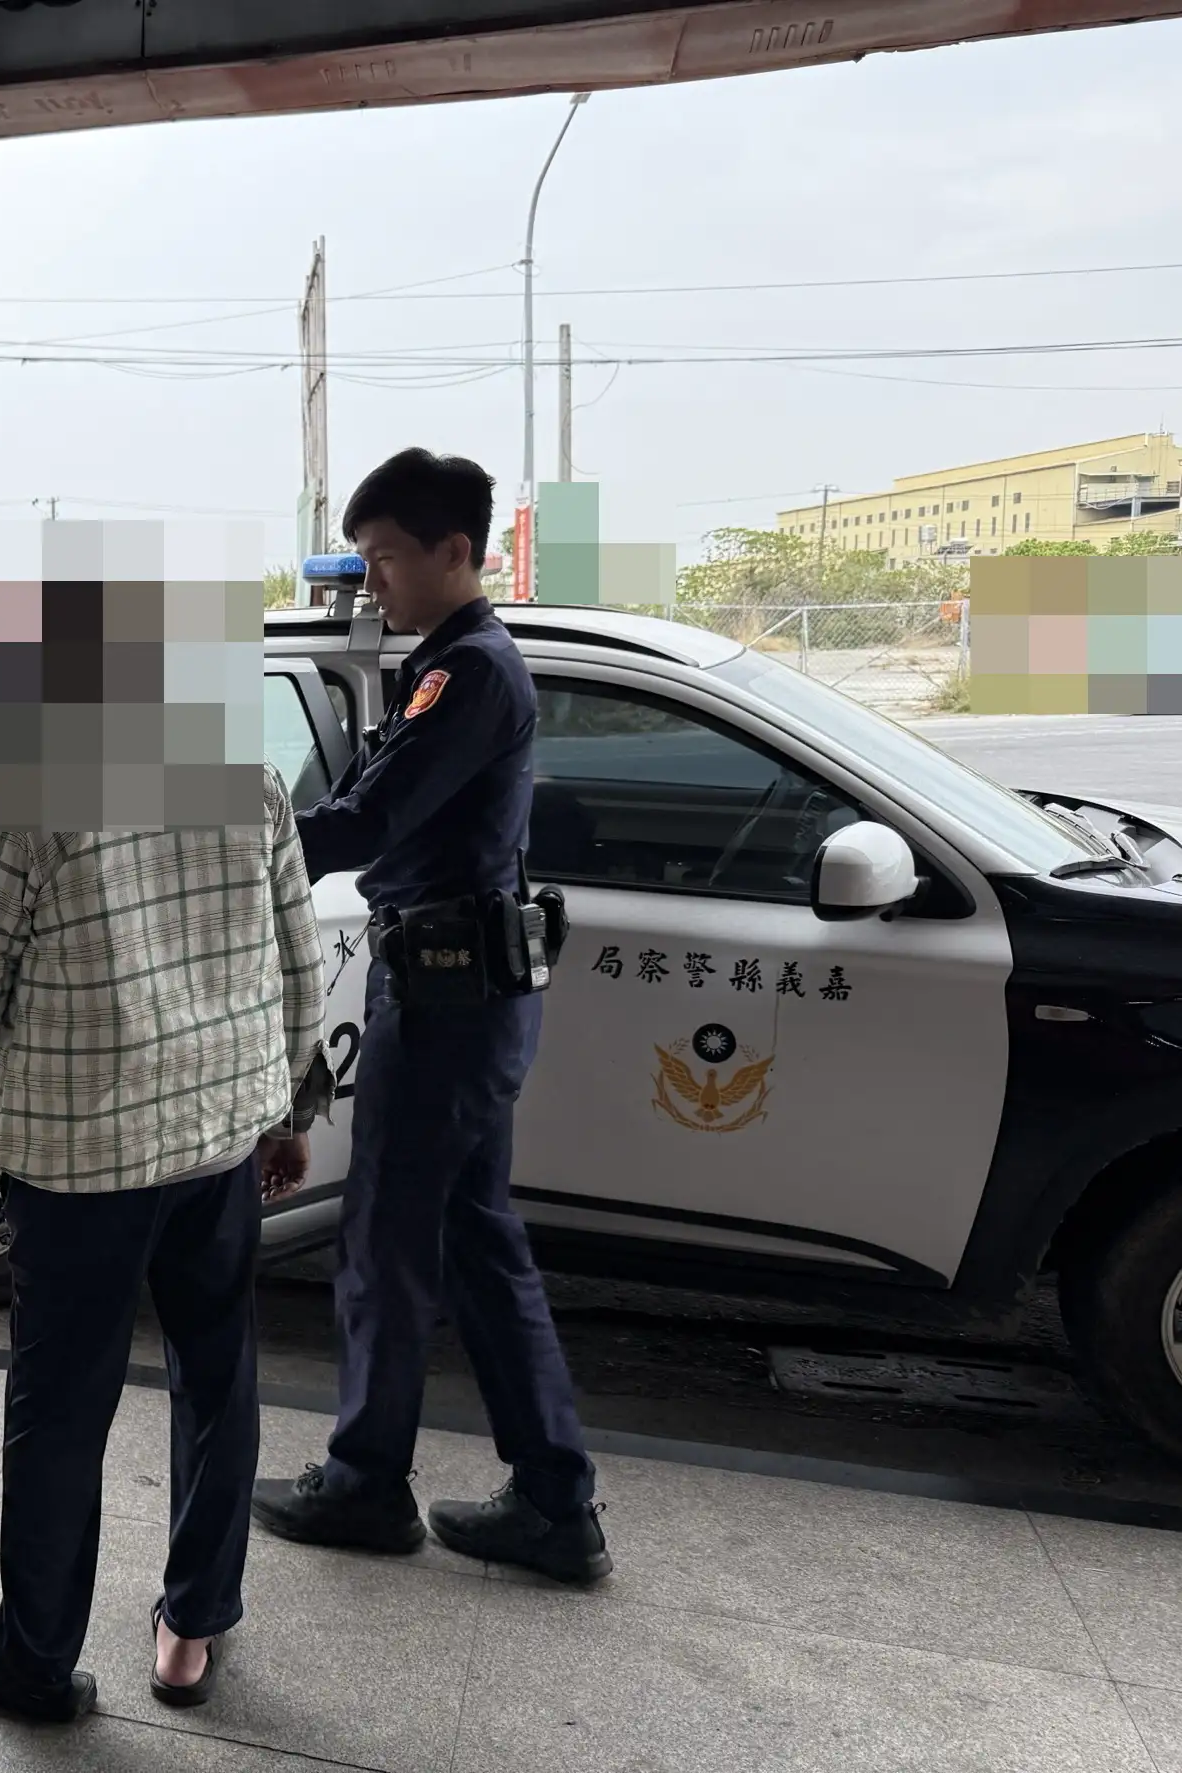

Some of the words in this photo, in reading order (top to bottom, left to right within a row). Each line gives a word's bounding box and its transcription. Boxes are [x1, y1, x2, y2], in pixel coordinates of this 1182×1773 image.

[334, 930, 355, 964] 水
[591, 946, 853, 1001] 嘉義縣警察局
[329, 1021, 361, 1100] 2
